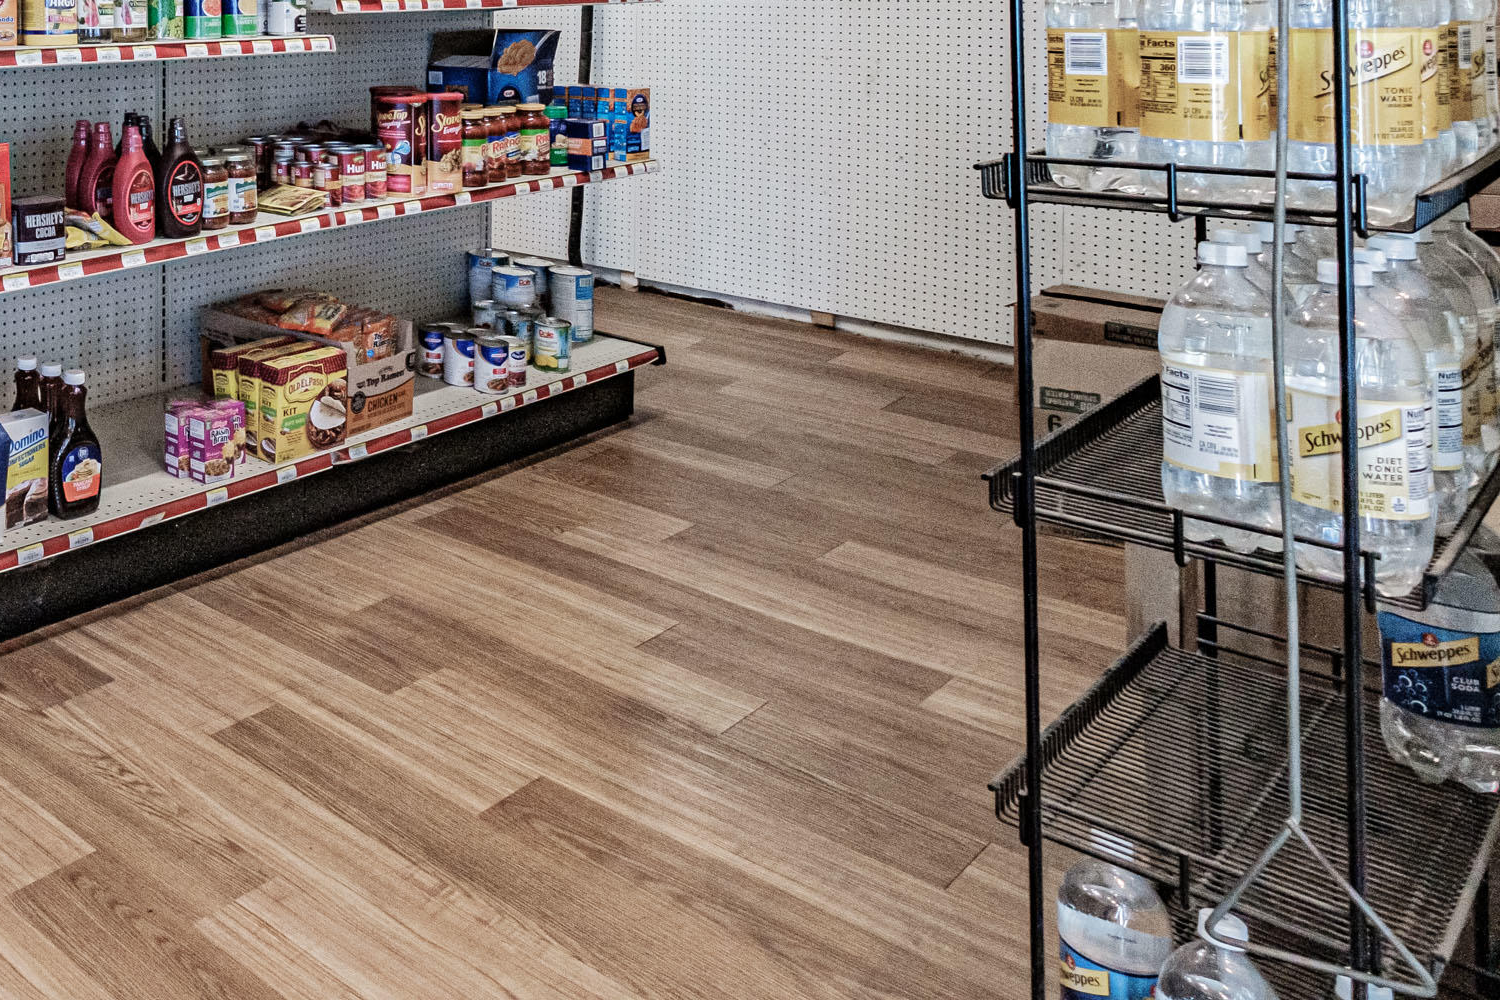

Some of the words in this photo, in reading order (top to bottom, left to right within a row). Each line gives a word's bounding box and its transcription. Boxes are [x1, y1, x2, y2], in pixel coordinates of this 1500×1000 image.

[1146, 39, 1176, 48] Facts
[1160, 63, 1176, 72] 360
[536, 70, 547, 85] 18
[1380, 95, 1413, 103] WATER
[25, 211, 64, 229] HERSHEY'S
[35, 226, 56, 239] COCOA
[1165, 366, 1190, 380] Facts
[368, 391, 398, 412] CHICKEN
[1181, 395, 1191, 404] 15
[282, 407, 297, 416] KIT
[210, 427, 230, 438] Raisin
[1304, 418, 1391, 453] Schwpes
[212, 435, 229, 444] Bran
[18, 455, 35, 468] SUGAR
[1376, 457, 1403, 465] DIET
[1368, 464, 1403, 473] TONIC
[1362, 473, 1404, 482] WATER
[1396, 645, 1471, 663] Schweppes
[1452, 676, 1480, 685] CLUB
[1451, 683, 1480, 692] SODA
